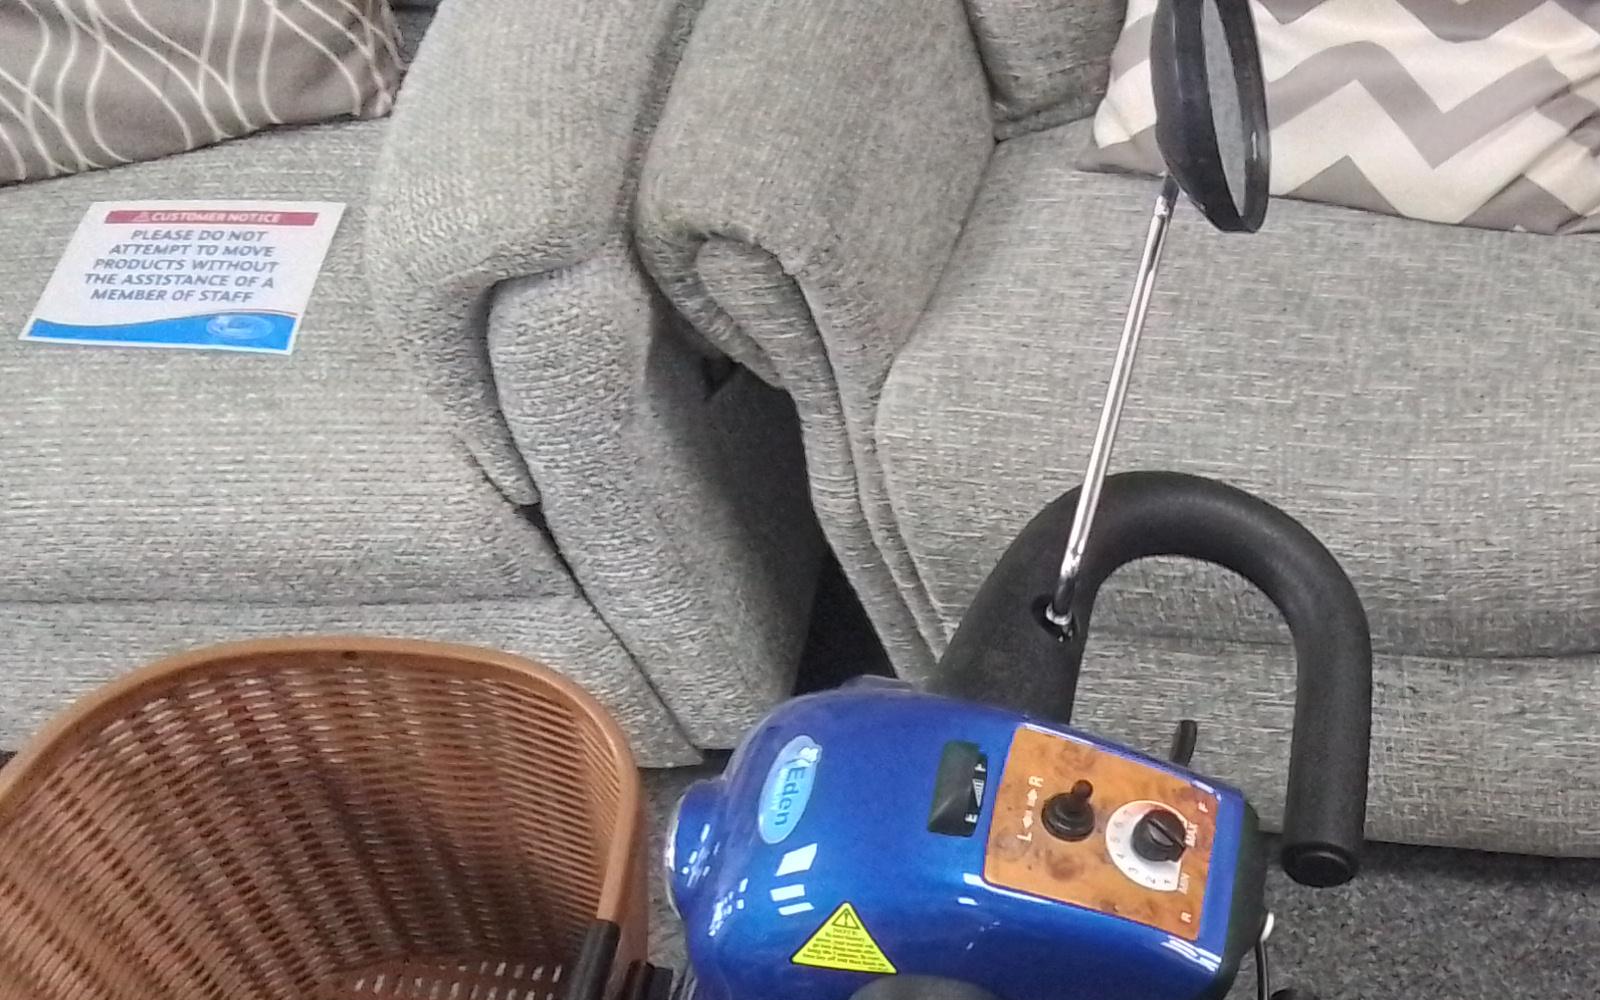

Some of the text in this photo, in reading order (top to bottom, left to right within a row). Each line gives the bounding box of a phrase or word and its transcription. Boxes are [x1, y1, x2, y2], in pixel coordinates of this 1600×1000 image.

[151, 211, 282, 225] CUSTOMER NOTICE
[130, 229, 268, 242] PLEASE DO NOT
[109, 244, 276, 258] ATTEMPT TO MOVE
[93, 258, 280, 273] PRODUCTS WITHOUT
[84, 273, 274, 289] THE ASSISTANCE OF A
[90, 288, 254, 303] MEMBER OF STAFF
[1028, 775, 1044, 788] R
[774, 766, 807, 826] Eden
[1198, 801, 1208, 813] F
[964, 812, 978, 824] E
[1016, 831, 1032, 842] L
[1180, 911, 1192, 923] R
